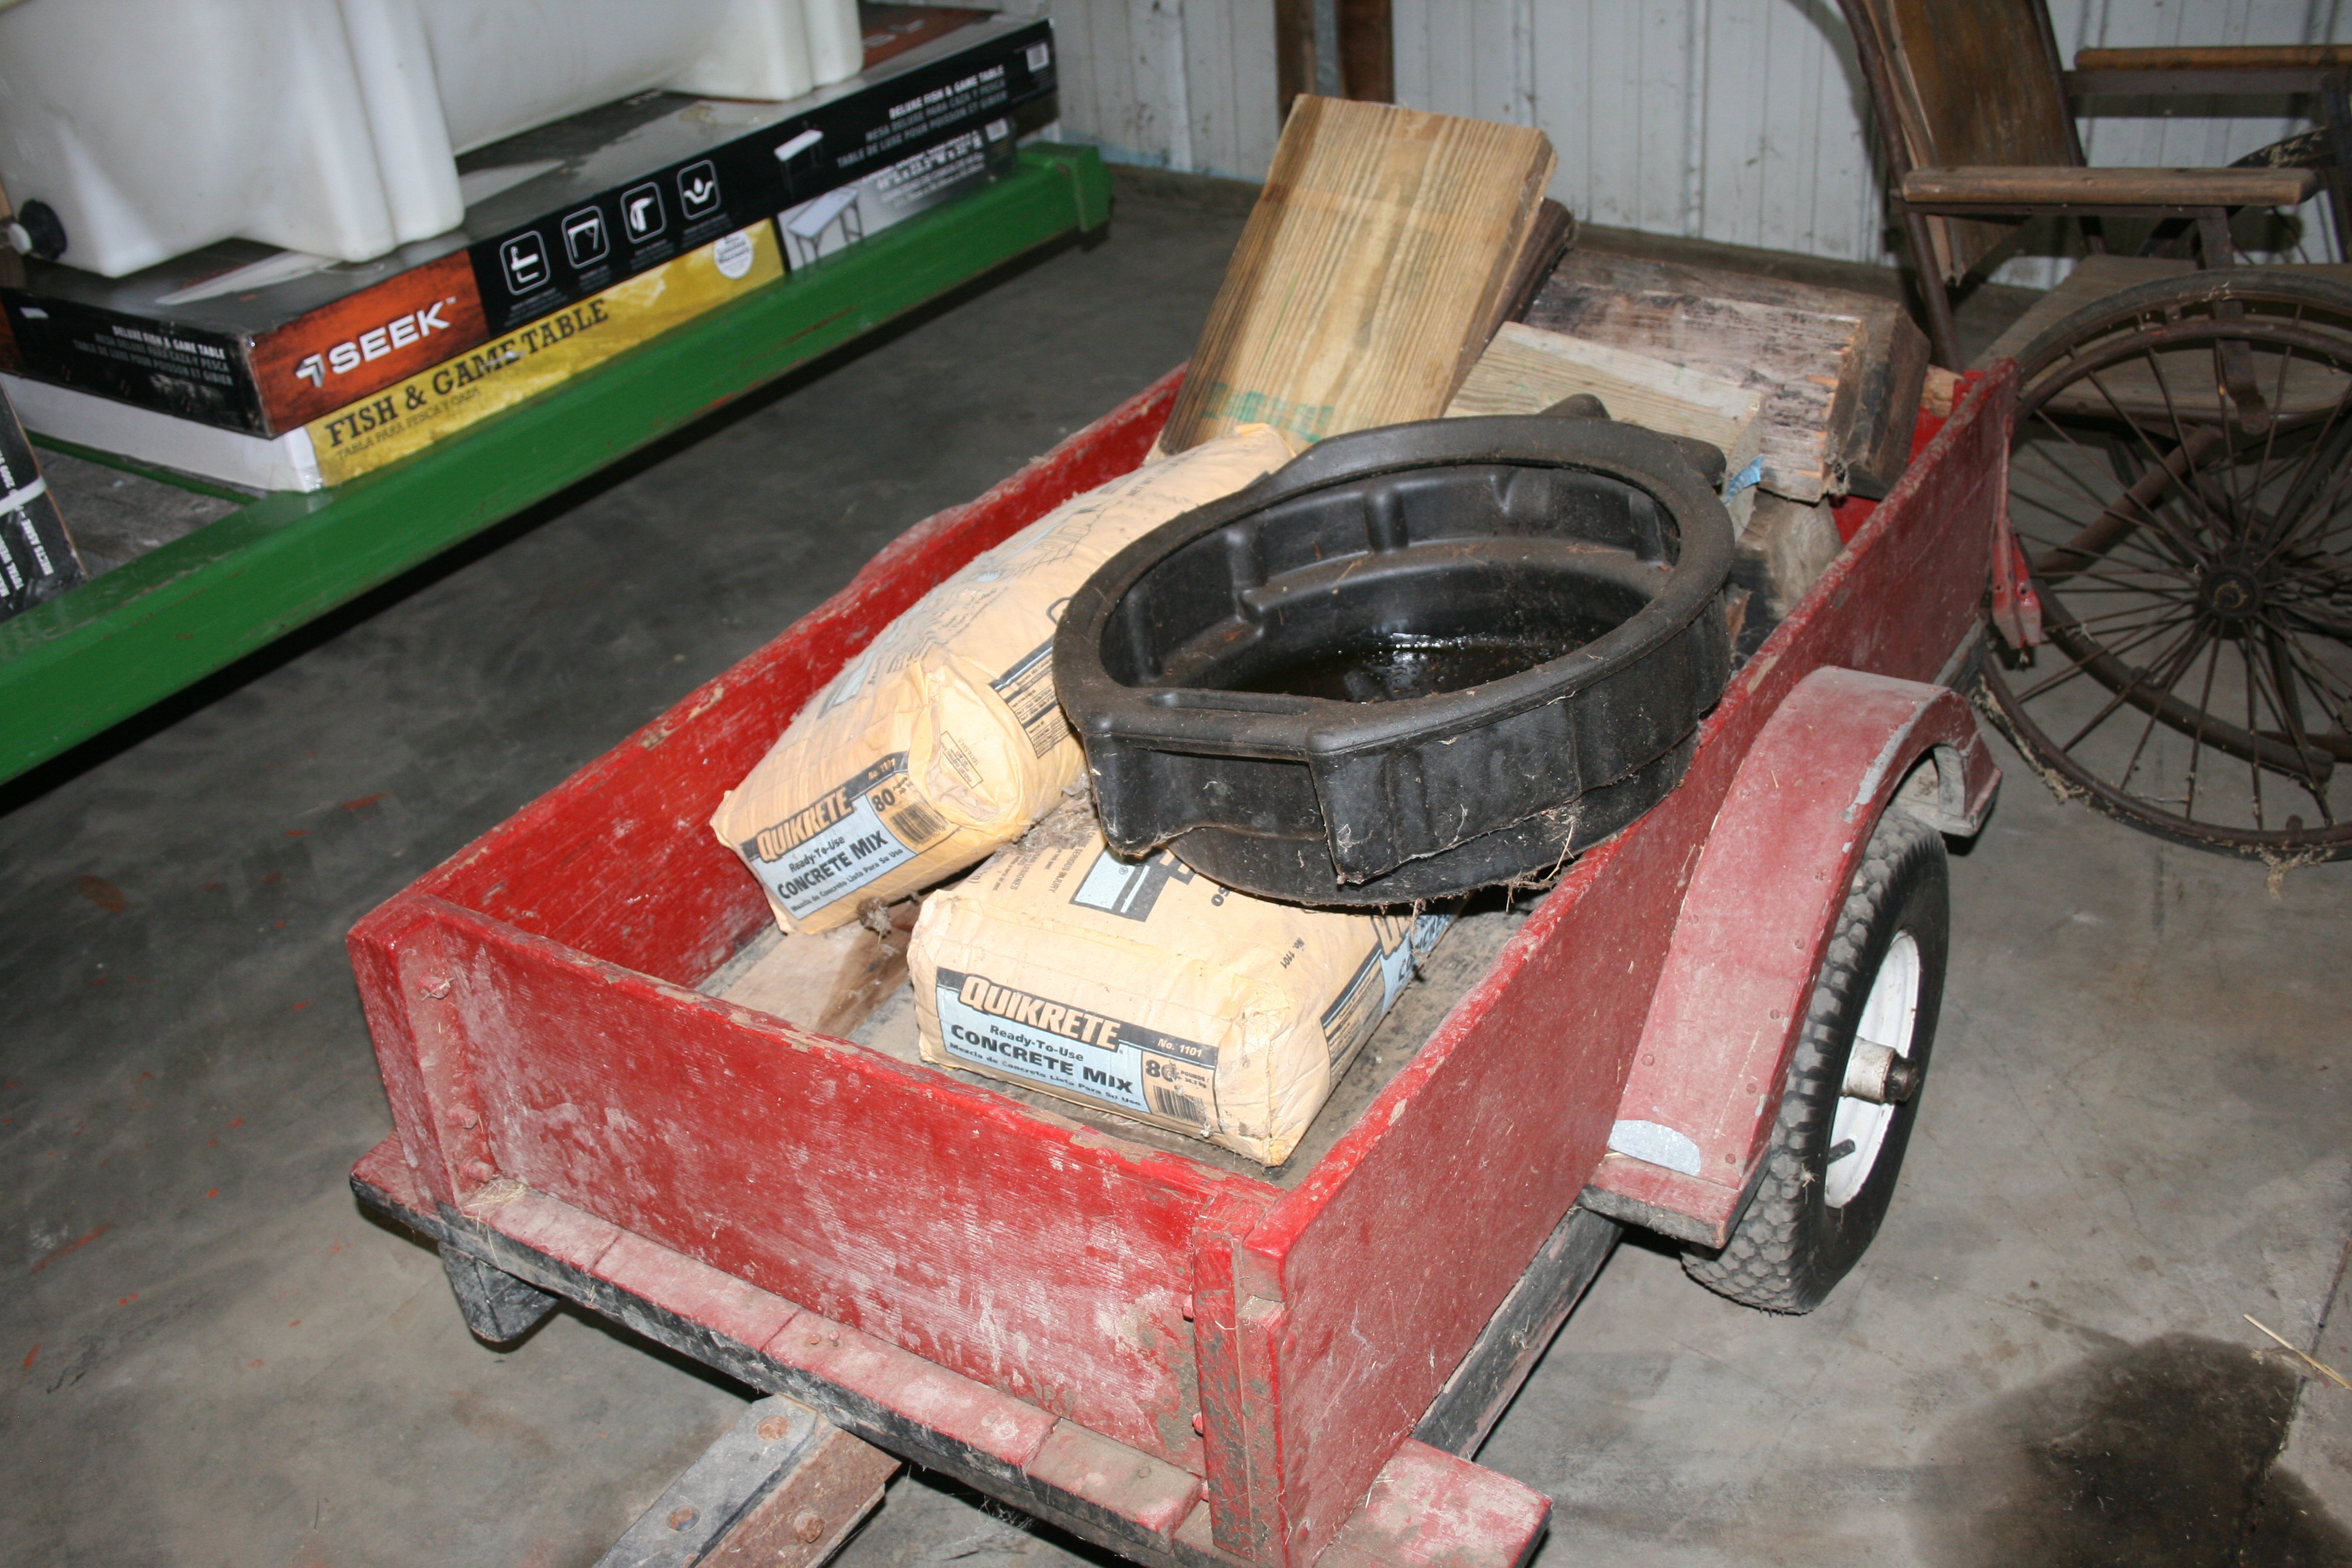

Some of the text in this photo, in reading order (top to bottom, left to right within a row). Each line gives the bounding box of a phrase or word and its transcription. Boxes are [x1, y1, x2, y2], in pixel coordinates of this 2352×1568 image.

[889, 96, 923, 120] DELUXE
[923, 88, 945, 105] FISH
[953, 74, 979, 94] GAME
[979, 64, 1005, 83] TABLE
[197, 343, 227, 361] TABLE
[328, 301, 451, 375] SEEK
[325, 395, 399, 448] FISH
[405, 385, 427, 411] &
[432, 339, 521, 396] GAME
[521, 298, 609, 354] TABLE
[376, 420, 405, 442] PARA
[871, 788, 895, 812] 80
[756, 787, 854, 863] QUIKRETE
[777, 851, 853, 900] CONCRETE
[848, 829, 889, 860] MIX
[788, 834, 846, 873] Ready-To-Use
[863, 861, 880, 875] Para
[878, 855, 889, 865] Su
[889, 848, 904, 858] Uso
[1061, 849, 1083, 875] SERIOUS
[1048, 871, 1067, 893] INJURY
[1279, 950, 1295, 969] 1101
[959, 976, 1120, 1051] QUIKRETE
[951, 1024, 1134, 1094] CONCRETE MIX
[989, 1024, 1084, 1062] Ready-To-Use
[1158, 1038, 1203, 1057] No. 1101
[949, 1042, 1142, 1106] Mezcla de Concreto Lista Para Su Uso
[1180, 1070, 1205, 1081] POUNDS
